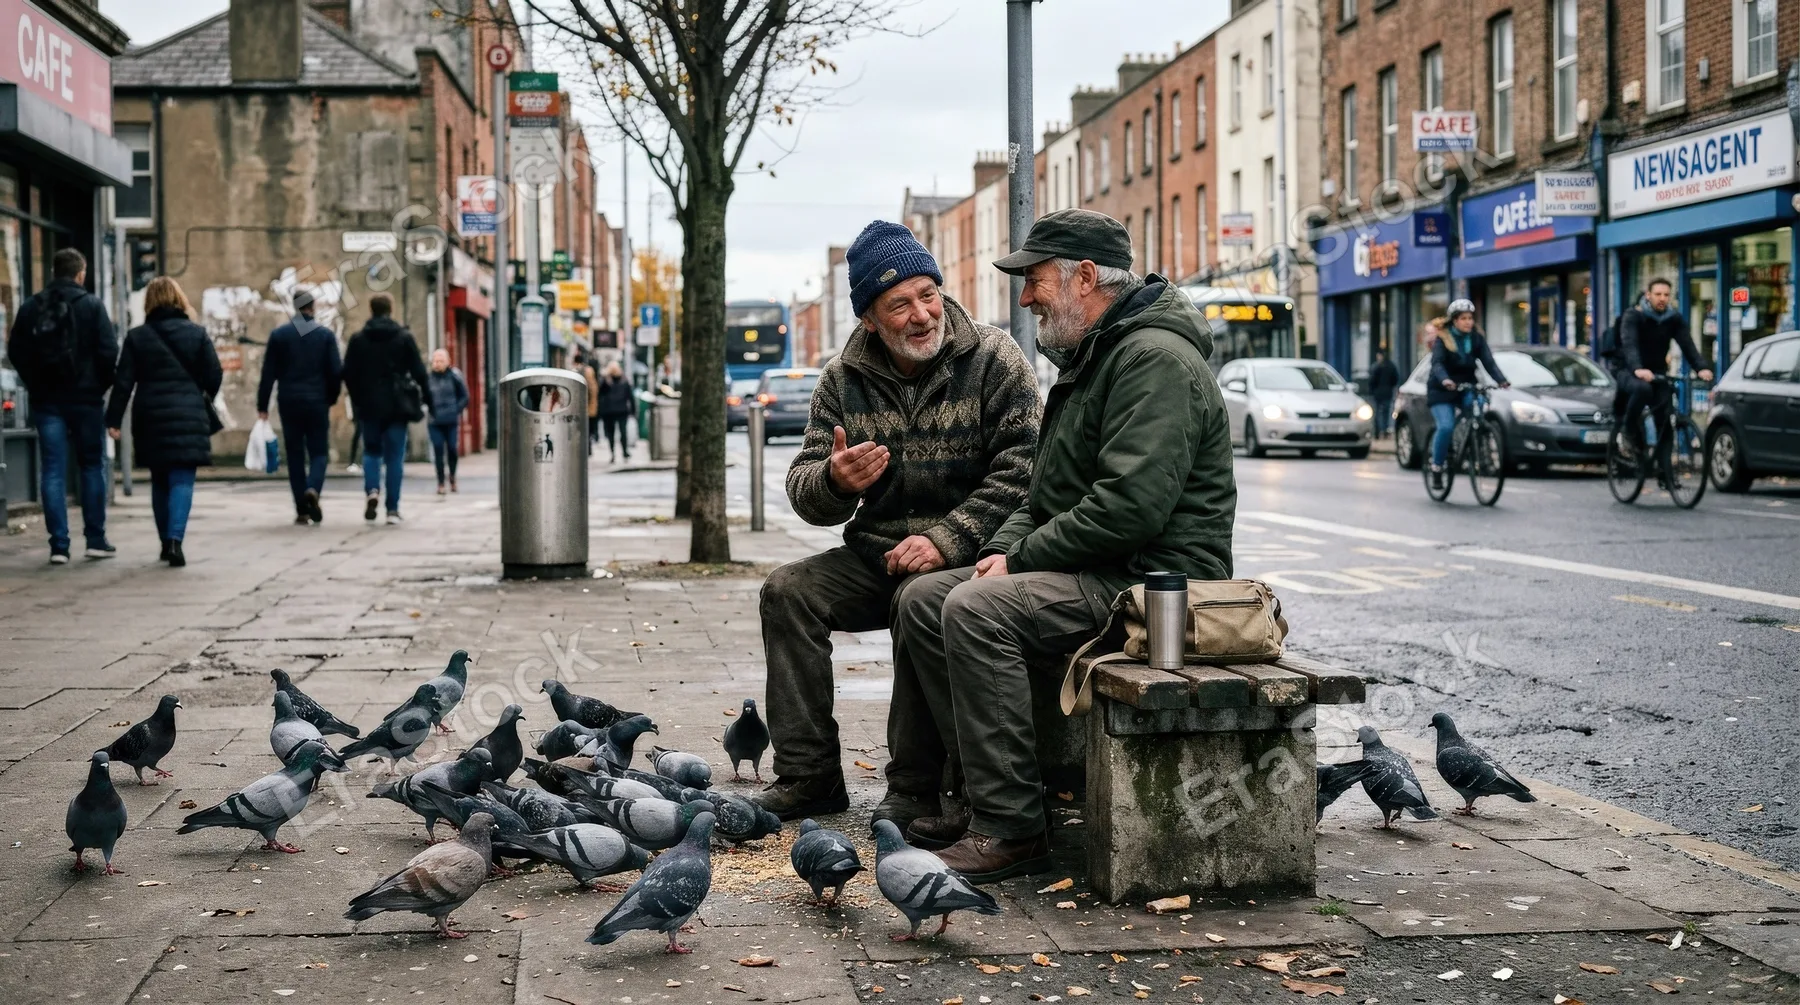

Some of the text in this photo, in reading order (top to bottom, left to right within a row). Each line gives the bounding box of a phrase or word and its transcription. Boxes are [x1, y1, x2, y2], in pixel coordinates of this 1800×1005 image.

[18, 13, 73, 103] CAFE
[1420, 116, 1472, 133] CAFE
[1634, 126, 1762, 190] NEWSAGENT
